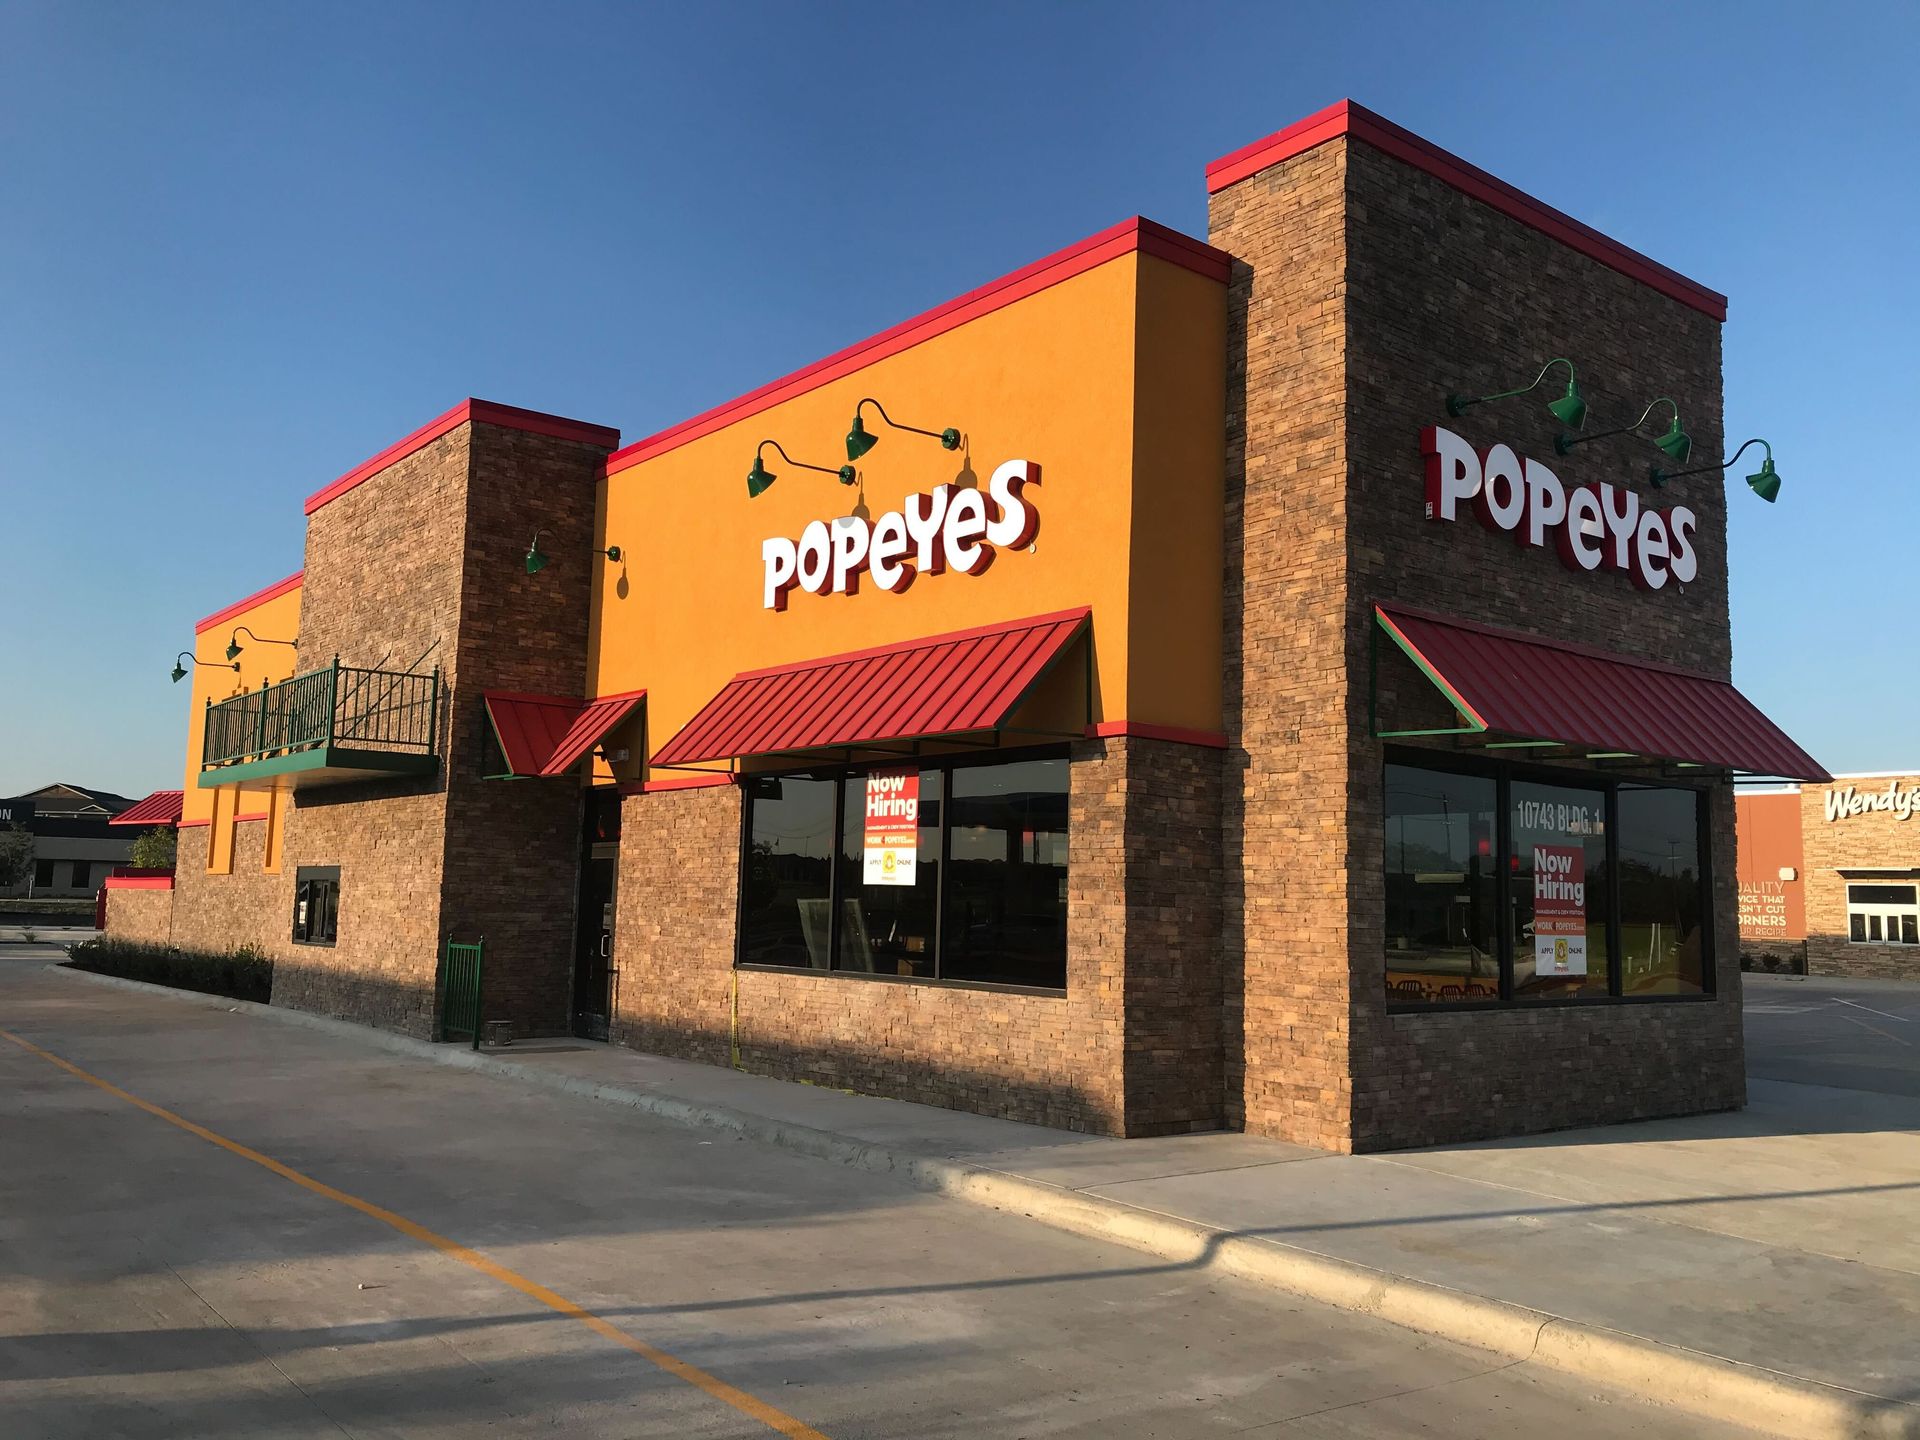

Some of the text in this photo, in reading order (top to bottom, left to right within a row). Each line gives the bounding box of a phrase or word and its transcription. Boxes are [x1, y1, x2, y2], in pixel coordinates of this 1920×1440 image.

[1424, 425, 1697, 590] POPeYeS
[762, 459, 1040, 612] POPeYeS
[868, 772, 905, 793] Now
[867, 792, 917, 821] Hiring
[1825, 781, 1920, 822] Wendy's
[1518, 800, 1600, 834] 10743 BLDG. 1
[1534, 848, 1572, 873] Now
[1535, 874, 1584, 906] Hiring
[1762, 895, 1785, 904] THAT
[1766, 905, 1786, 914] CUT
[1755, 927, 1787, 936] RECIPE
